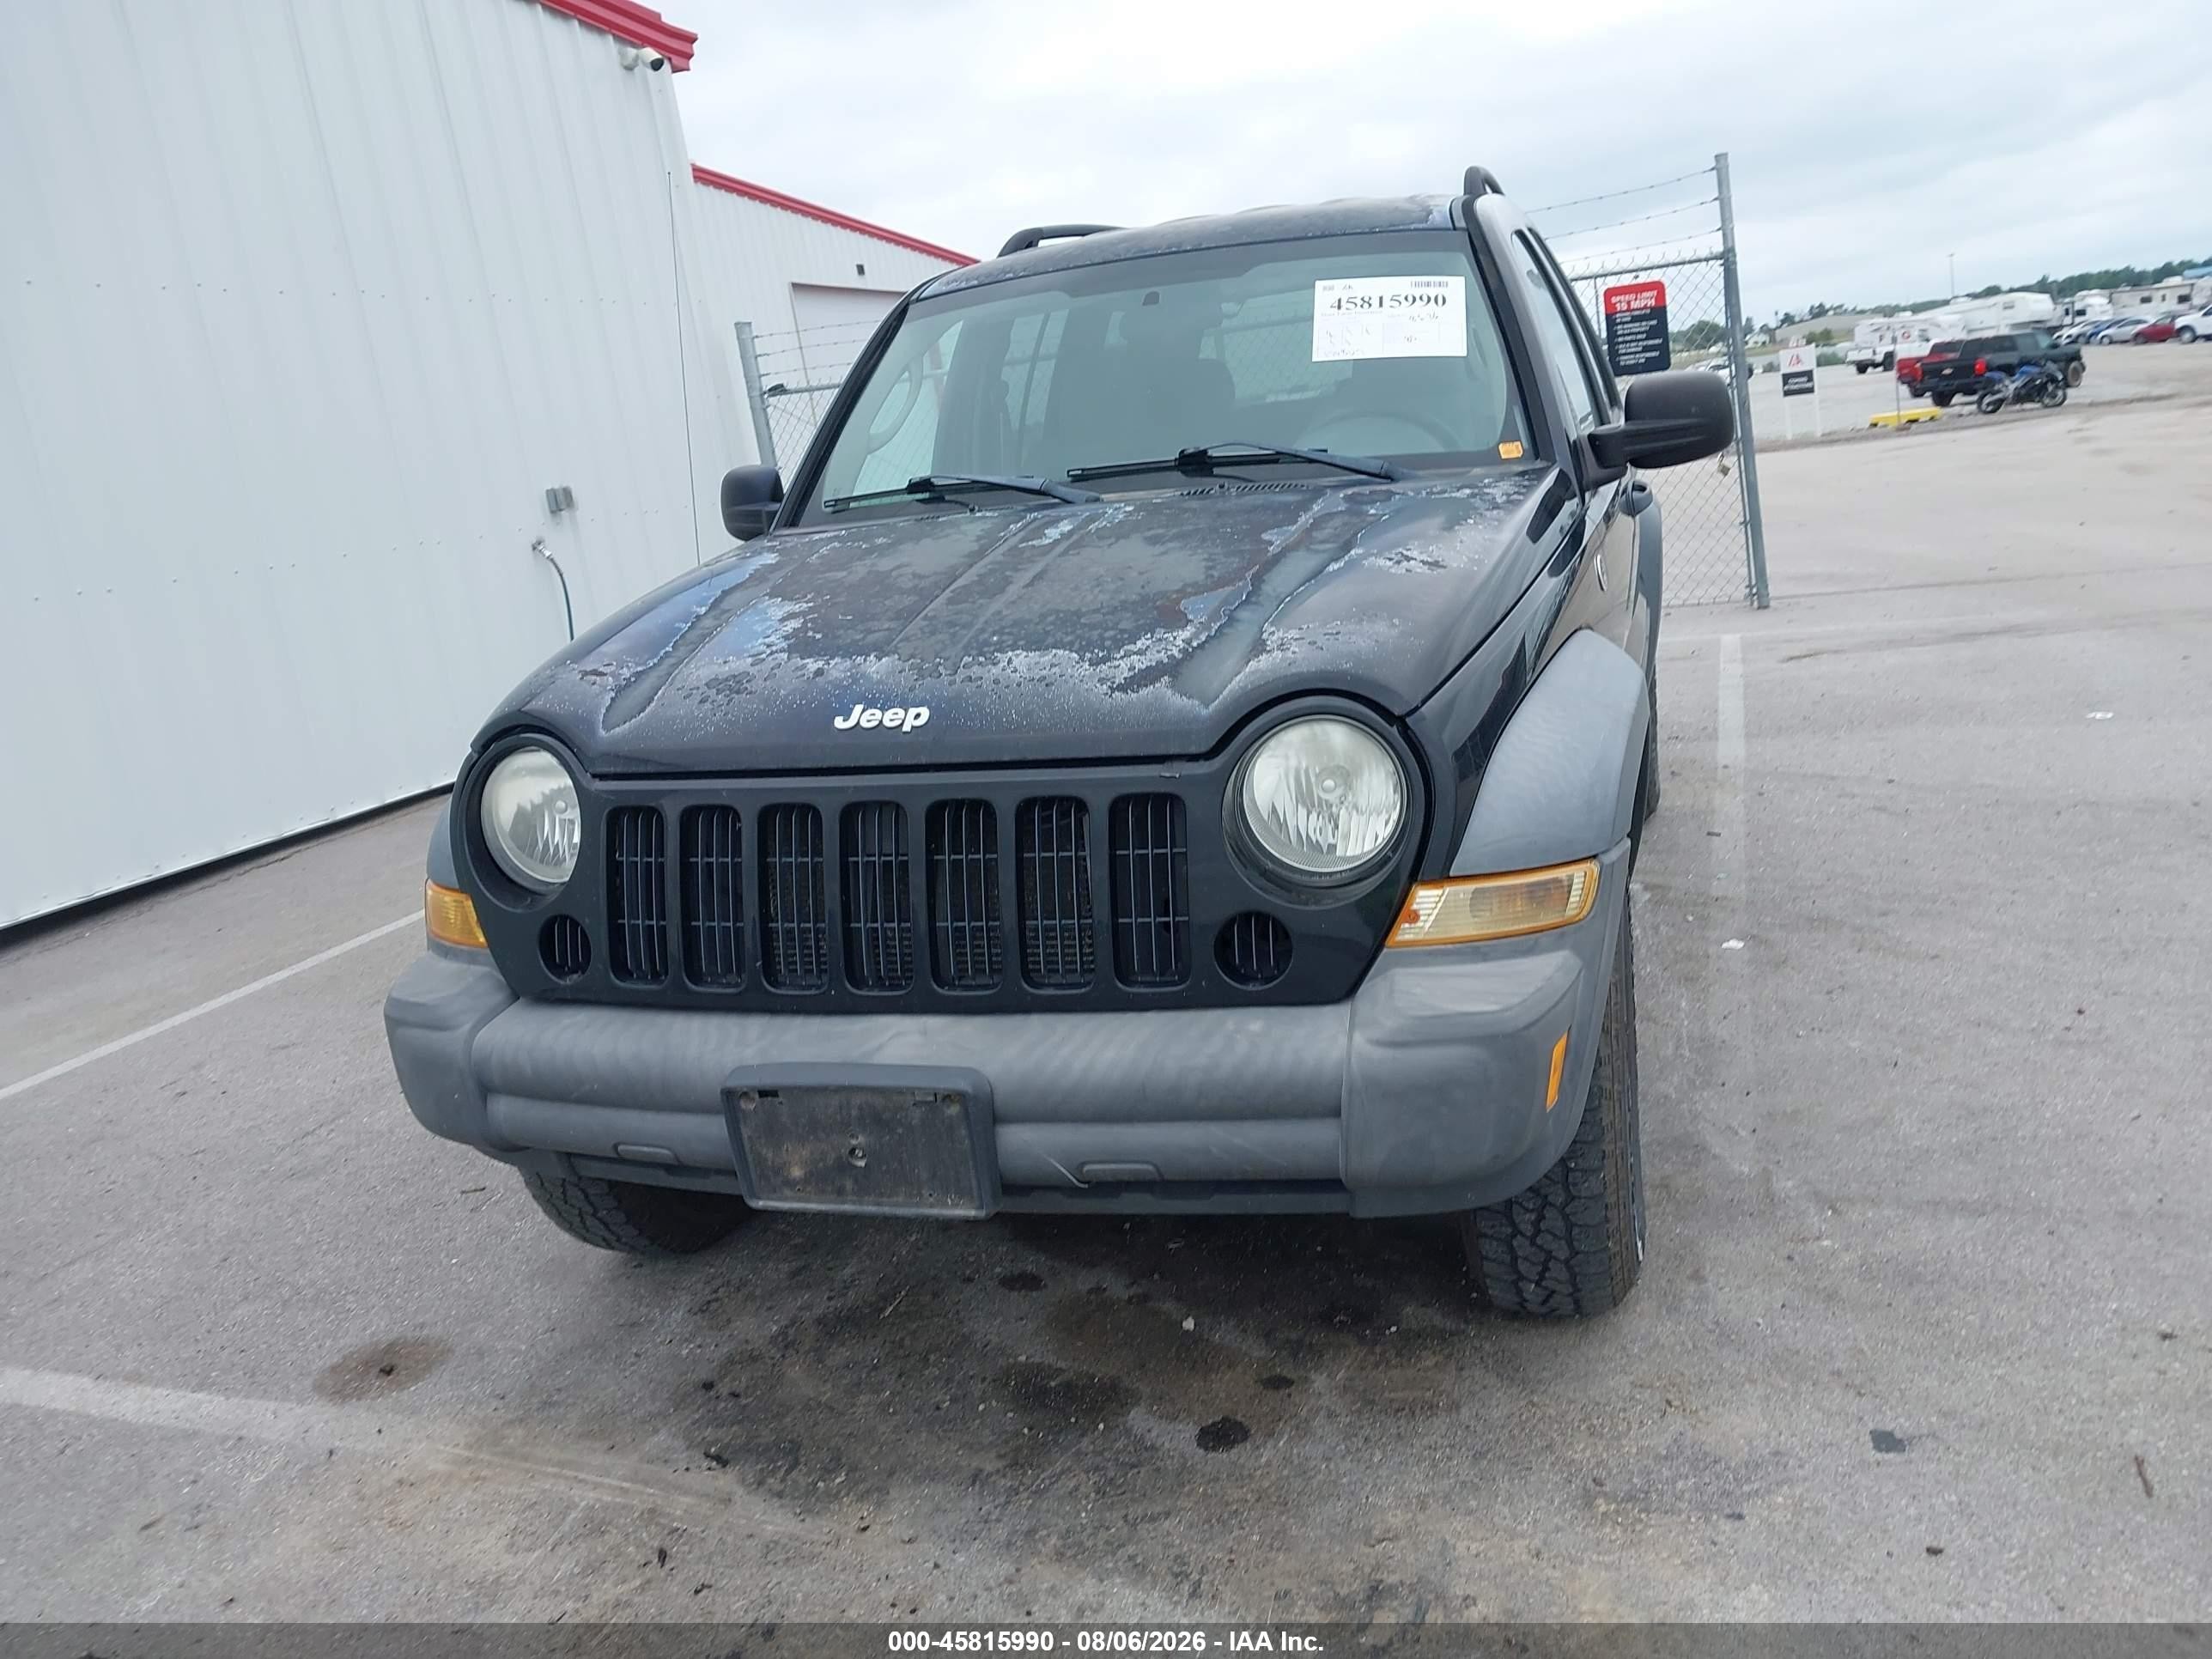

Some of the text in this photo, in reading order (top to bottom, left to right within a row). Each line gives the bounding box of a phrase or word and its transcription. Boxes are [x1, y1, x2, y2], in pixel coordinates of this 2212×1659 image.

[1330, 293, 1447, 311] 45815990
[1611, 289, 1657, 303] SPEED LIMIT
[1615, 296, 1656, 311] 15 MPH
[834, 703, 930, 732] Jeep
